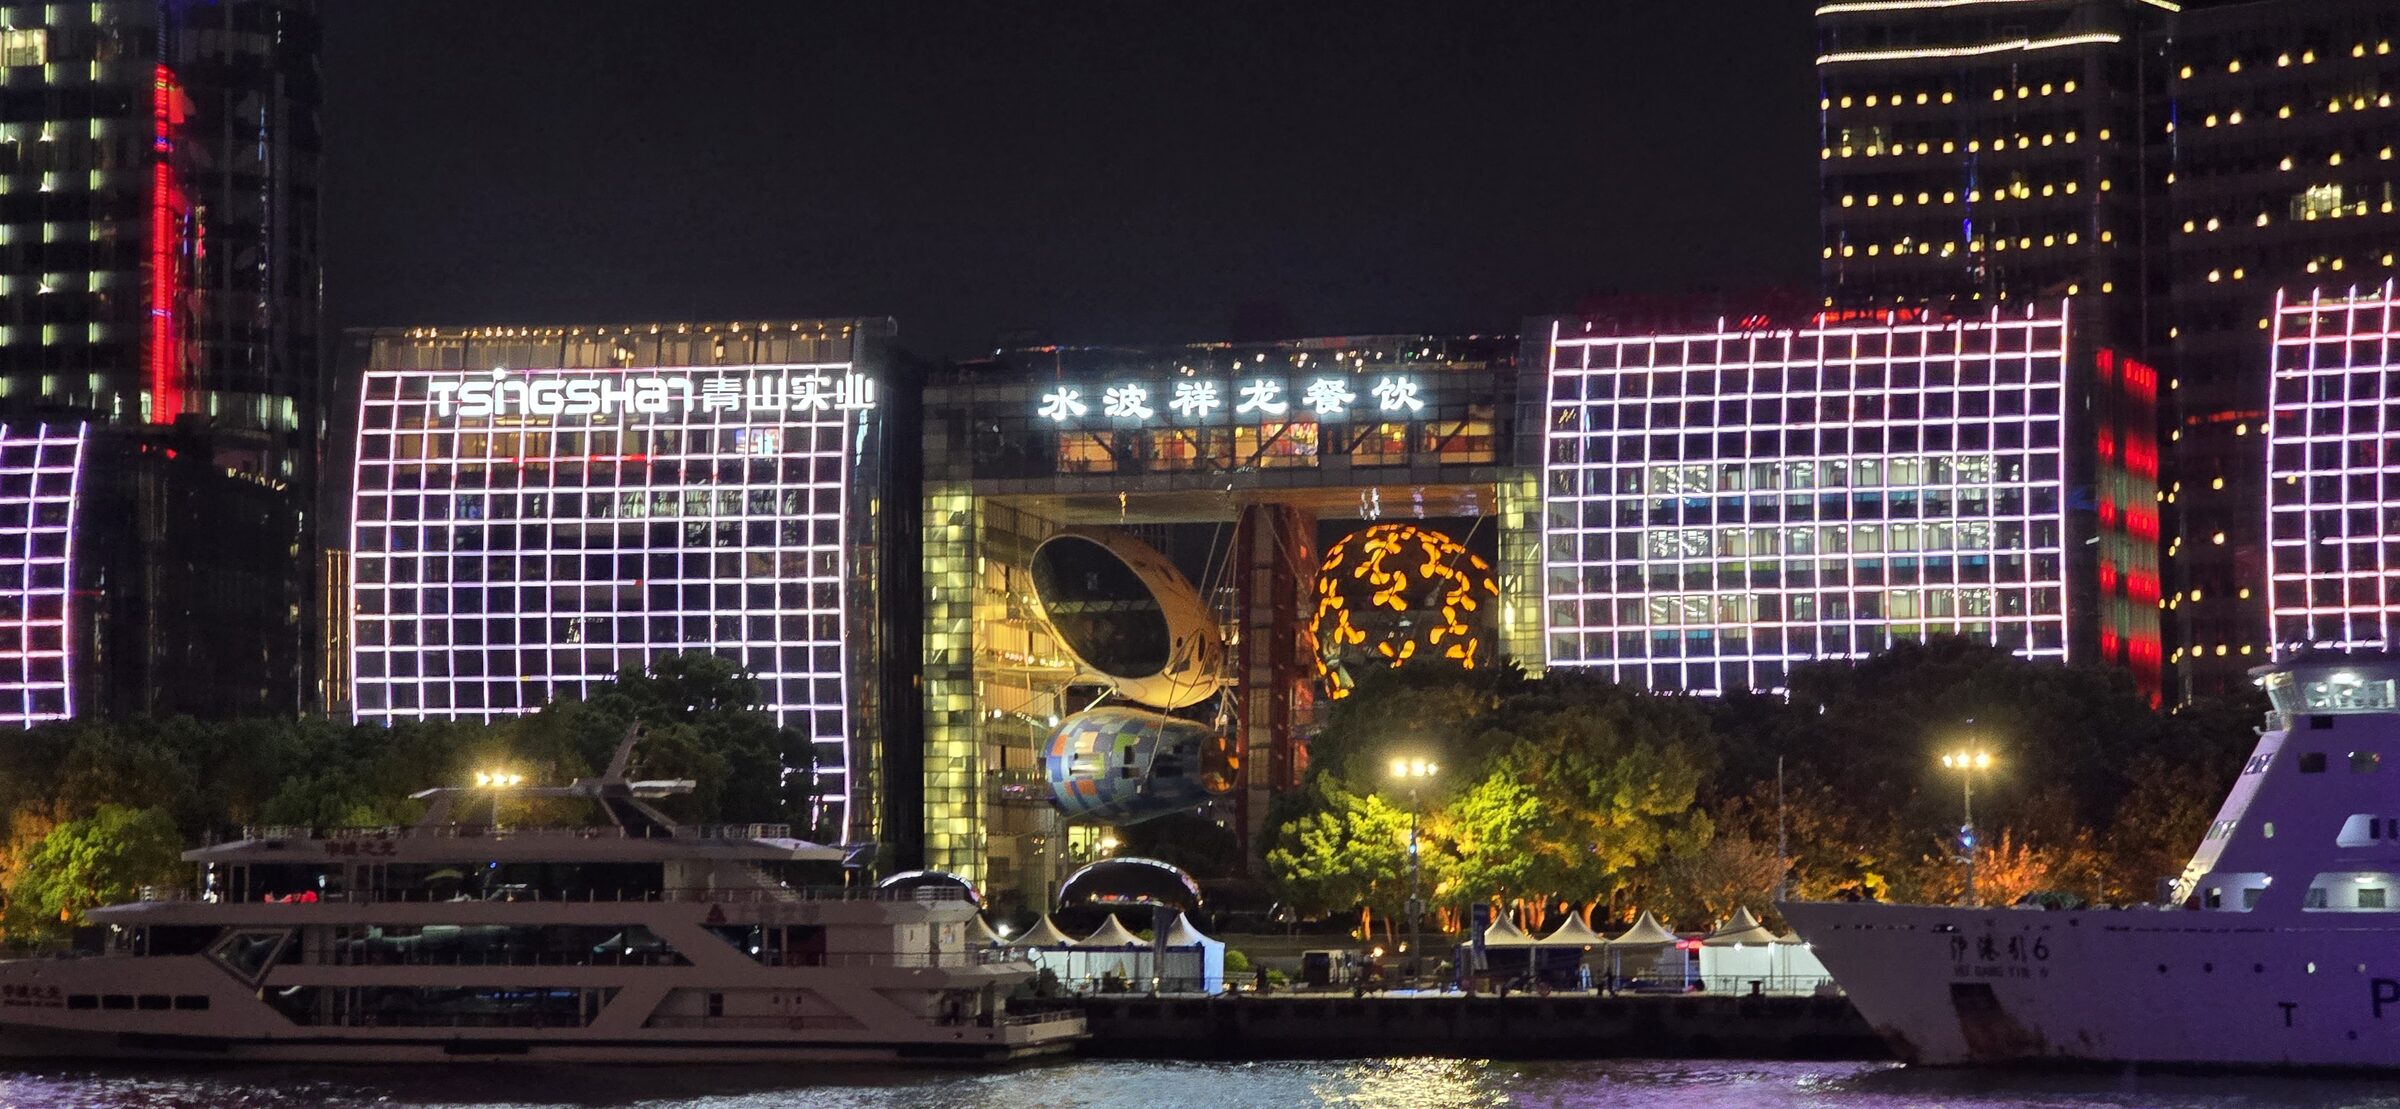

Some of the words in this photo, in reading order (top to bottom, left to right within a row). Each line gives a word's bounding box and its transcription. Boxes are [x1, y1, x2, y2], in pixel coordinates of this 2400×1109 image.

[701, 373, 876, 413] 青山实业
[1037, 376, 1425, 421] 水波祥龙餐饮
[2278, 1001, 2298, 1028] T
